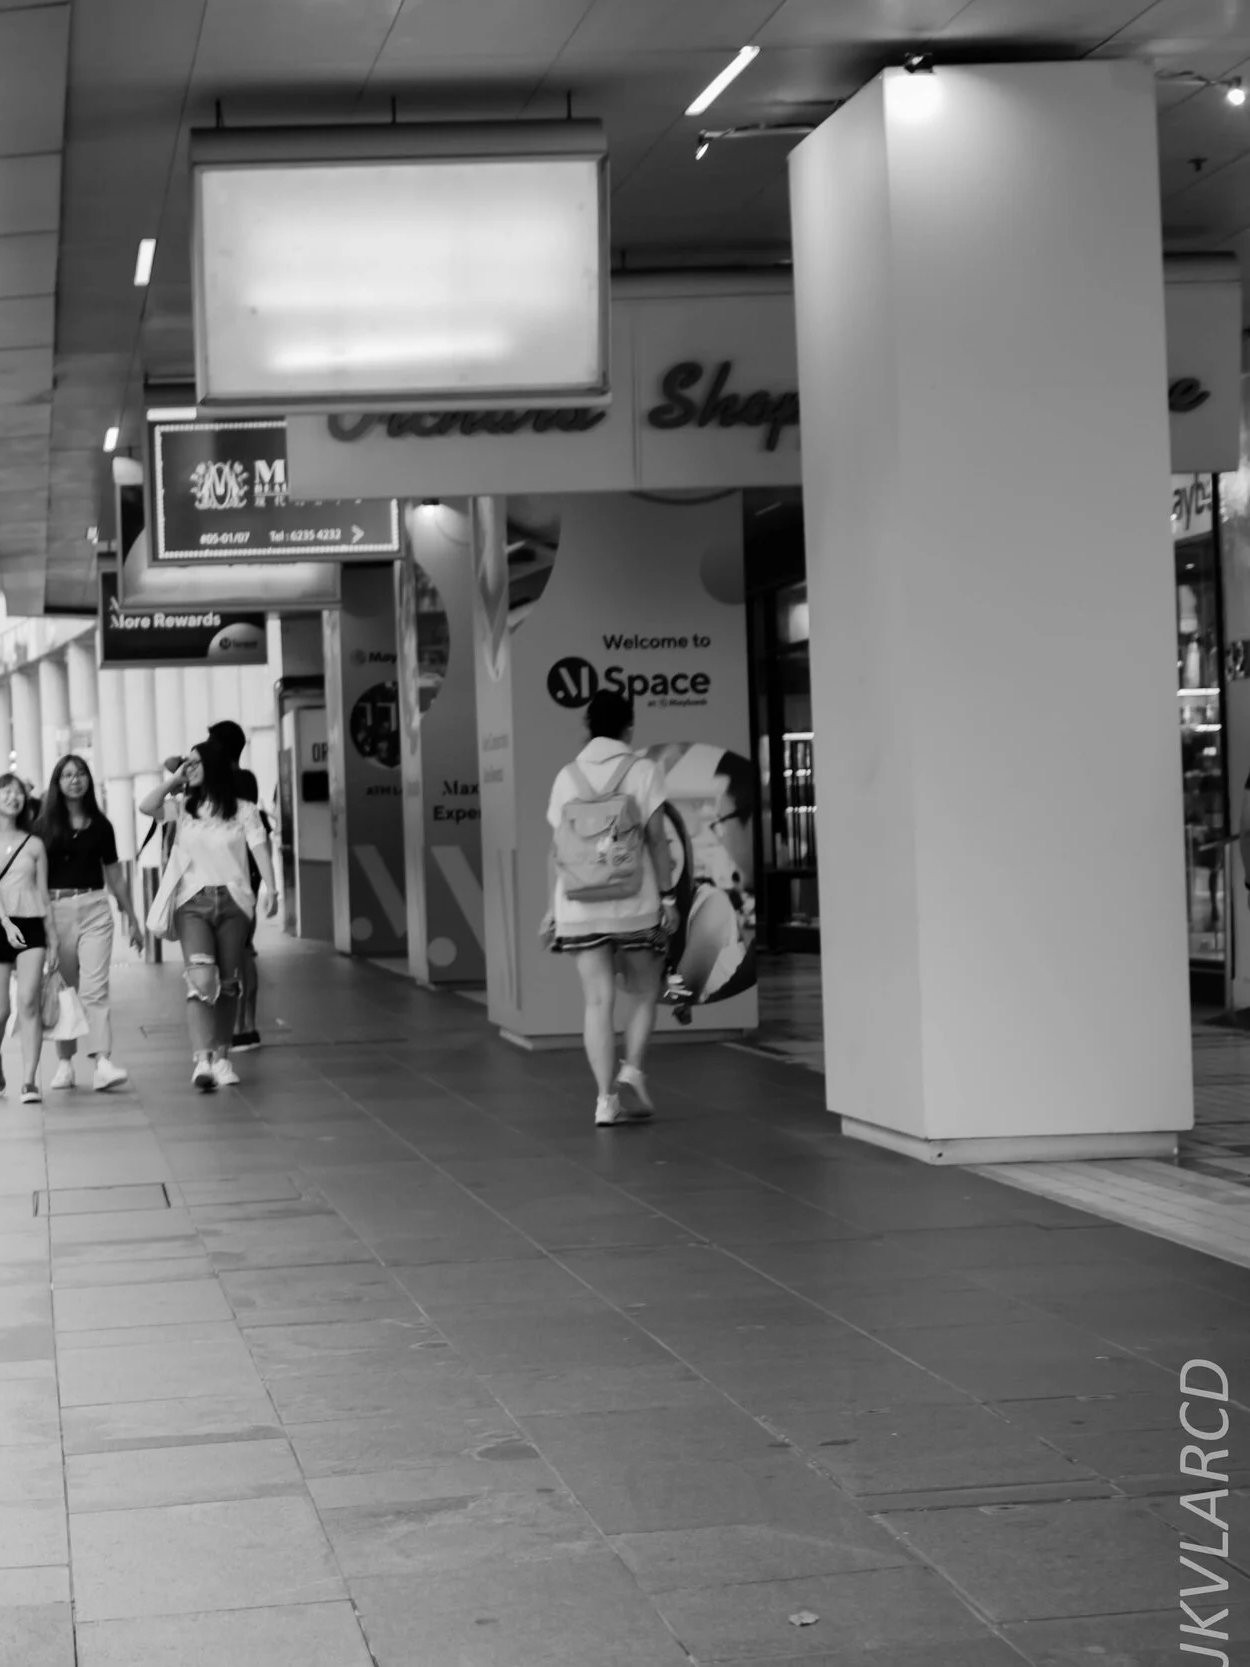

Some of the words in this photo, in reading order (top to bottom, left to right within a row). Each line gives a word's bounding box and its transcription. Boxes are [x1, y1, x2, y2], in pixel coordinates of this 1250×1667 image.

[648, 360, 799, 451] Shop
[154, 611, 221, 628] Rewards
[603, 634, 688, 650] Welcome
[693, 633, 711, 648] to
[604, 665, 711, 700] Space
[442, 780, 479, 796] Max
